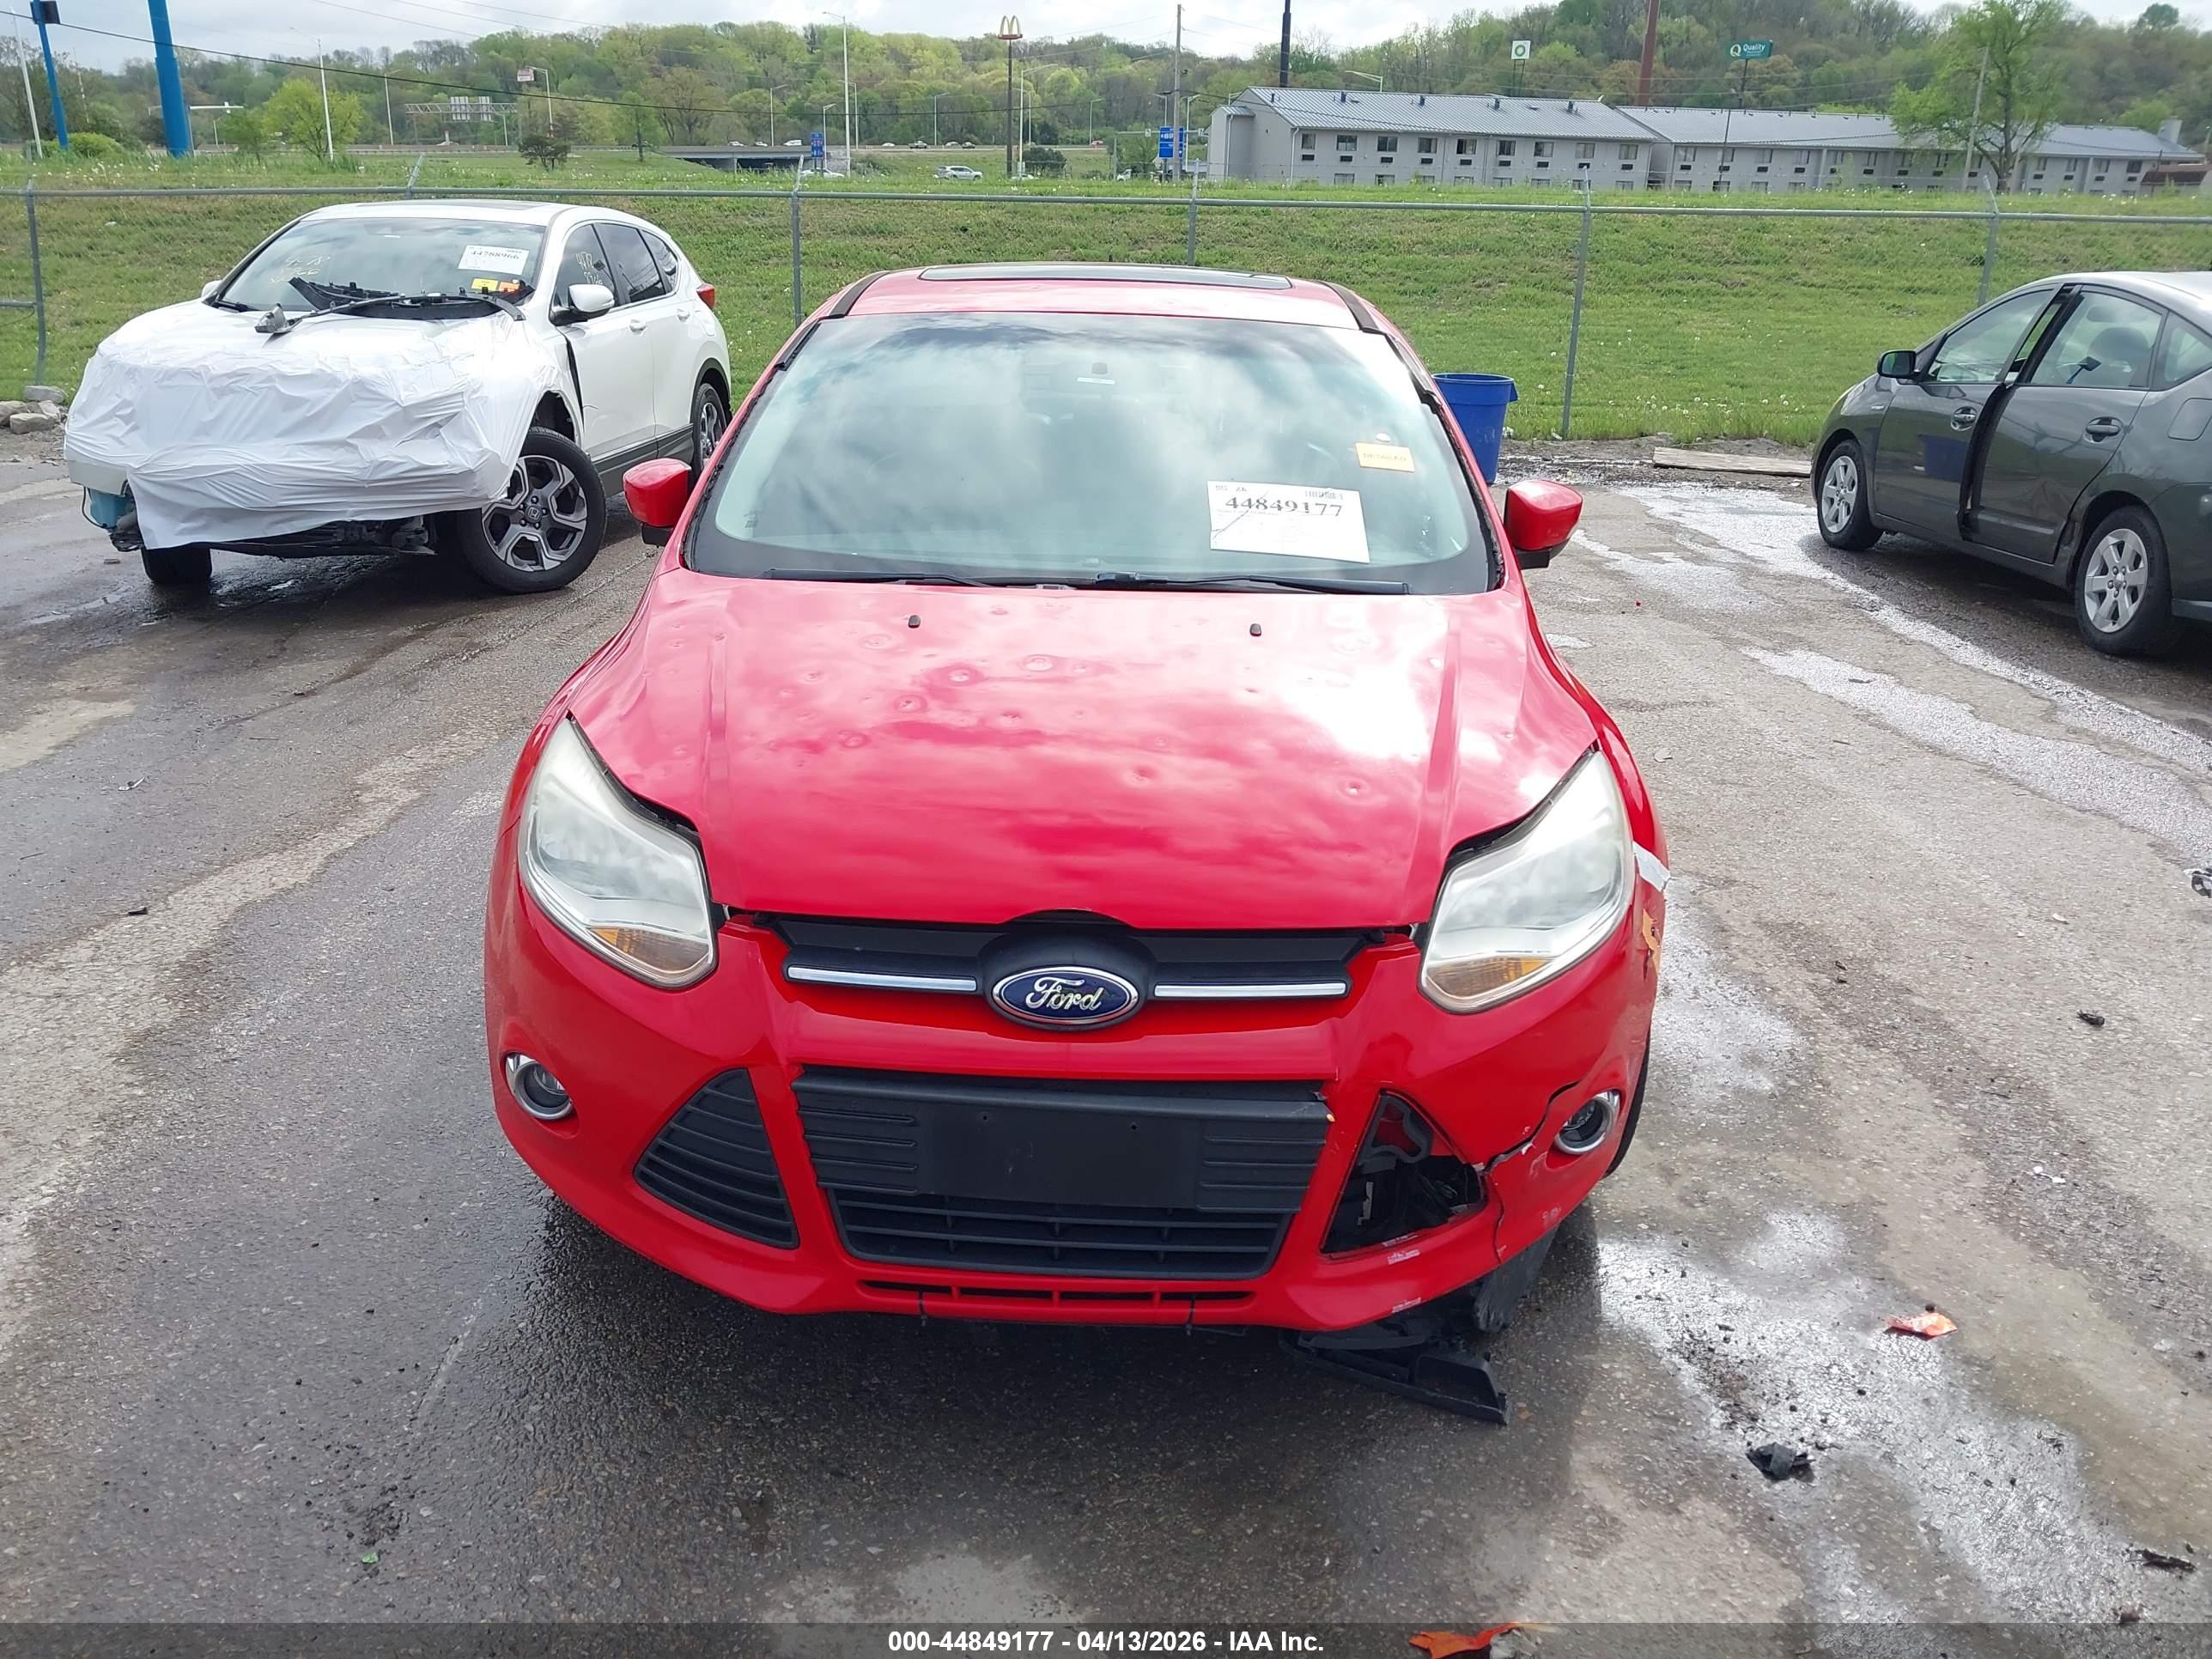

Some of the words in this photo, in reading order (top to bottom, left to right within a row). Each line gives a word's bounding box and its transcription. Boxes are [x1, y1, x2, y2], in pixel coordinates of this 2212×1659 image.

[1743, 43, 1765, 52] Quality
[1225, 496, 1343, 517] 44849177
[1025, 975, 1105, 1011] Ford
